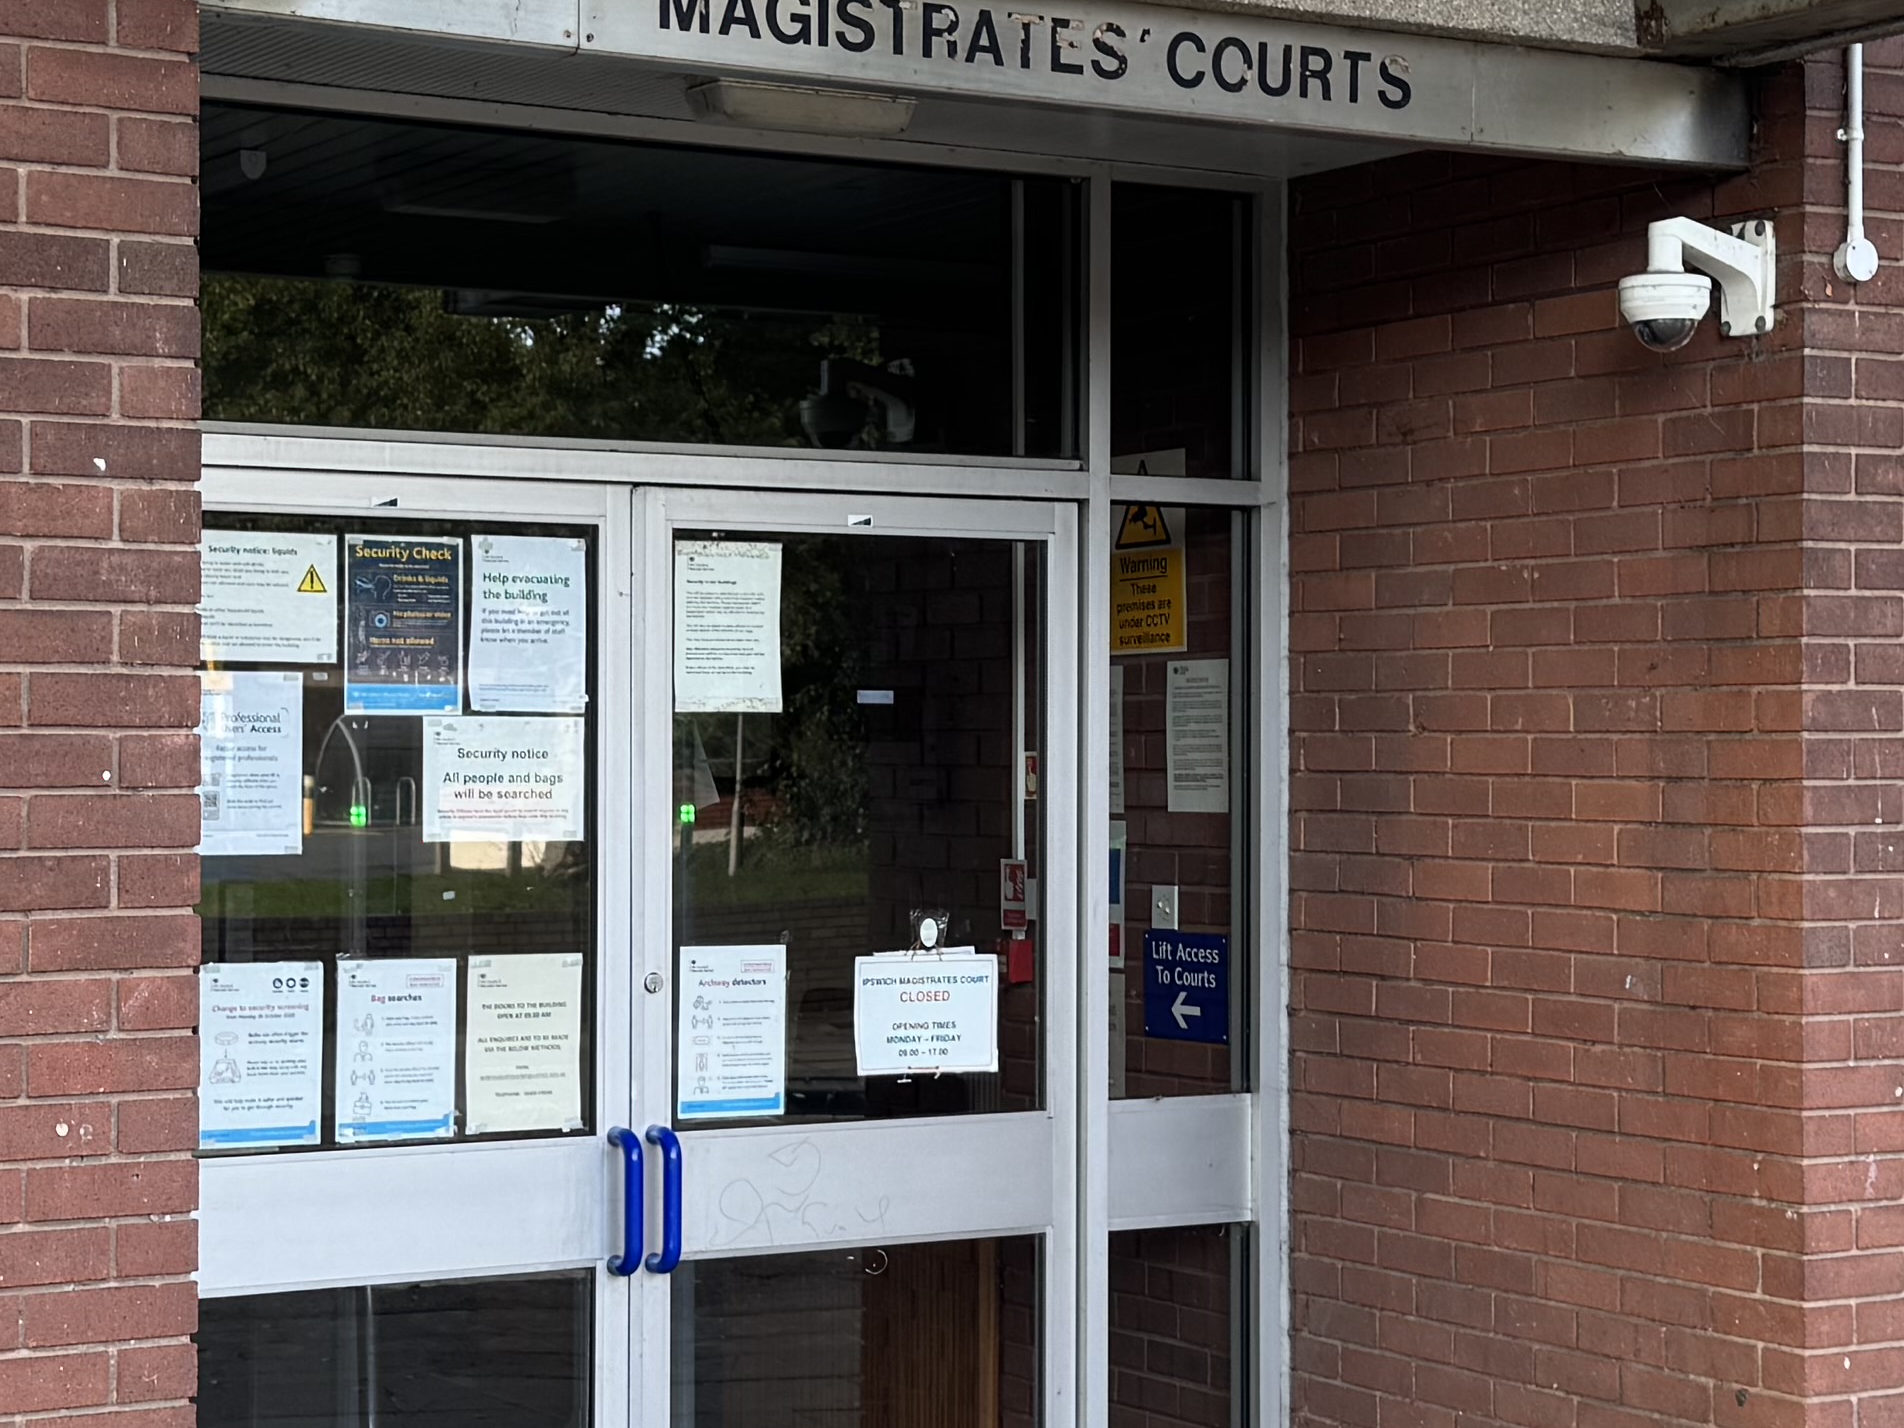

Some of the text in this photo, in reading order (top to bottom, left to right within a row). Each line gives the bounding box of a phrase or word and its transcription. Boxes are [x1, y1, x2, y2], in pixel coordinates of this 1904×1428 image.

[1166, 30, 1413, 111] COURTS
[208, 545, 241, 556] Security
[356, 545, 452, 561] Security Check
[1120, 556, 1168, 575] Warning
[483, 572, 570, 587] Help evacuating
[1131, 583, 1156, 596] These
[483, 590, 548, 603] the building
[1117, 599, 1172, 616] premises are
[1119, 613, 1171, 629] under CCTV
[1119, 632, 1171, 646] surveillance
[250, 724, 282, 733] Access
[458, 748, 548, 761] Security notice
[443, 772, 564, 786] All people and bags
[454, 788, 552, 799] will be searched
[1152, 941, 1219, 964] Lift Access
[698, 978, 766, 988] Archway detectors
[862, 976, 989, 986] IPSWICH MAGISTRATES COURT
[1156, 965, 1216, 988] To Courts
[371, 994, 422, 1004] Bag searches
[900, 990, 950, 1002] CLOSED
[892, 1021, 956, 1030] OPENING TIMES
[886, 1036, 922, 1044] MONDAY
[931, 1034, 961, 1042] FRIDAY
